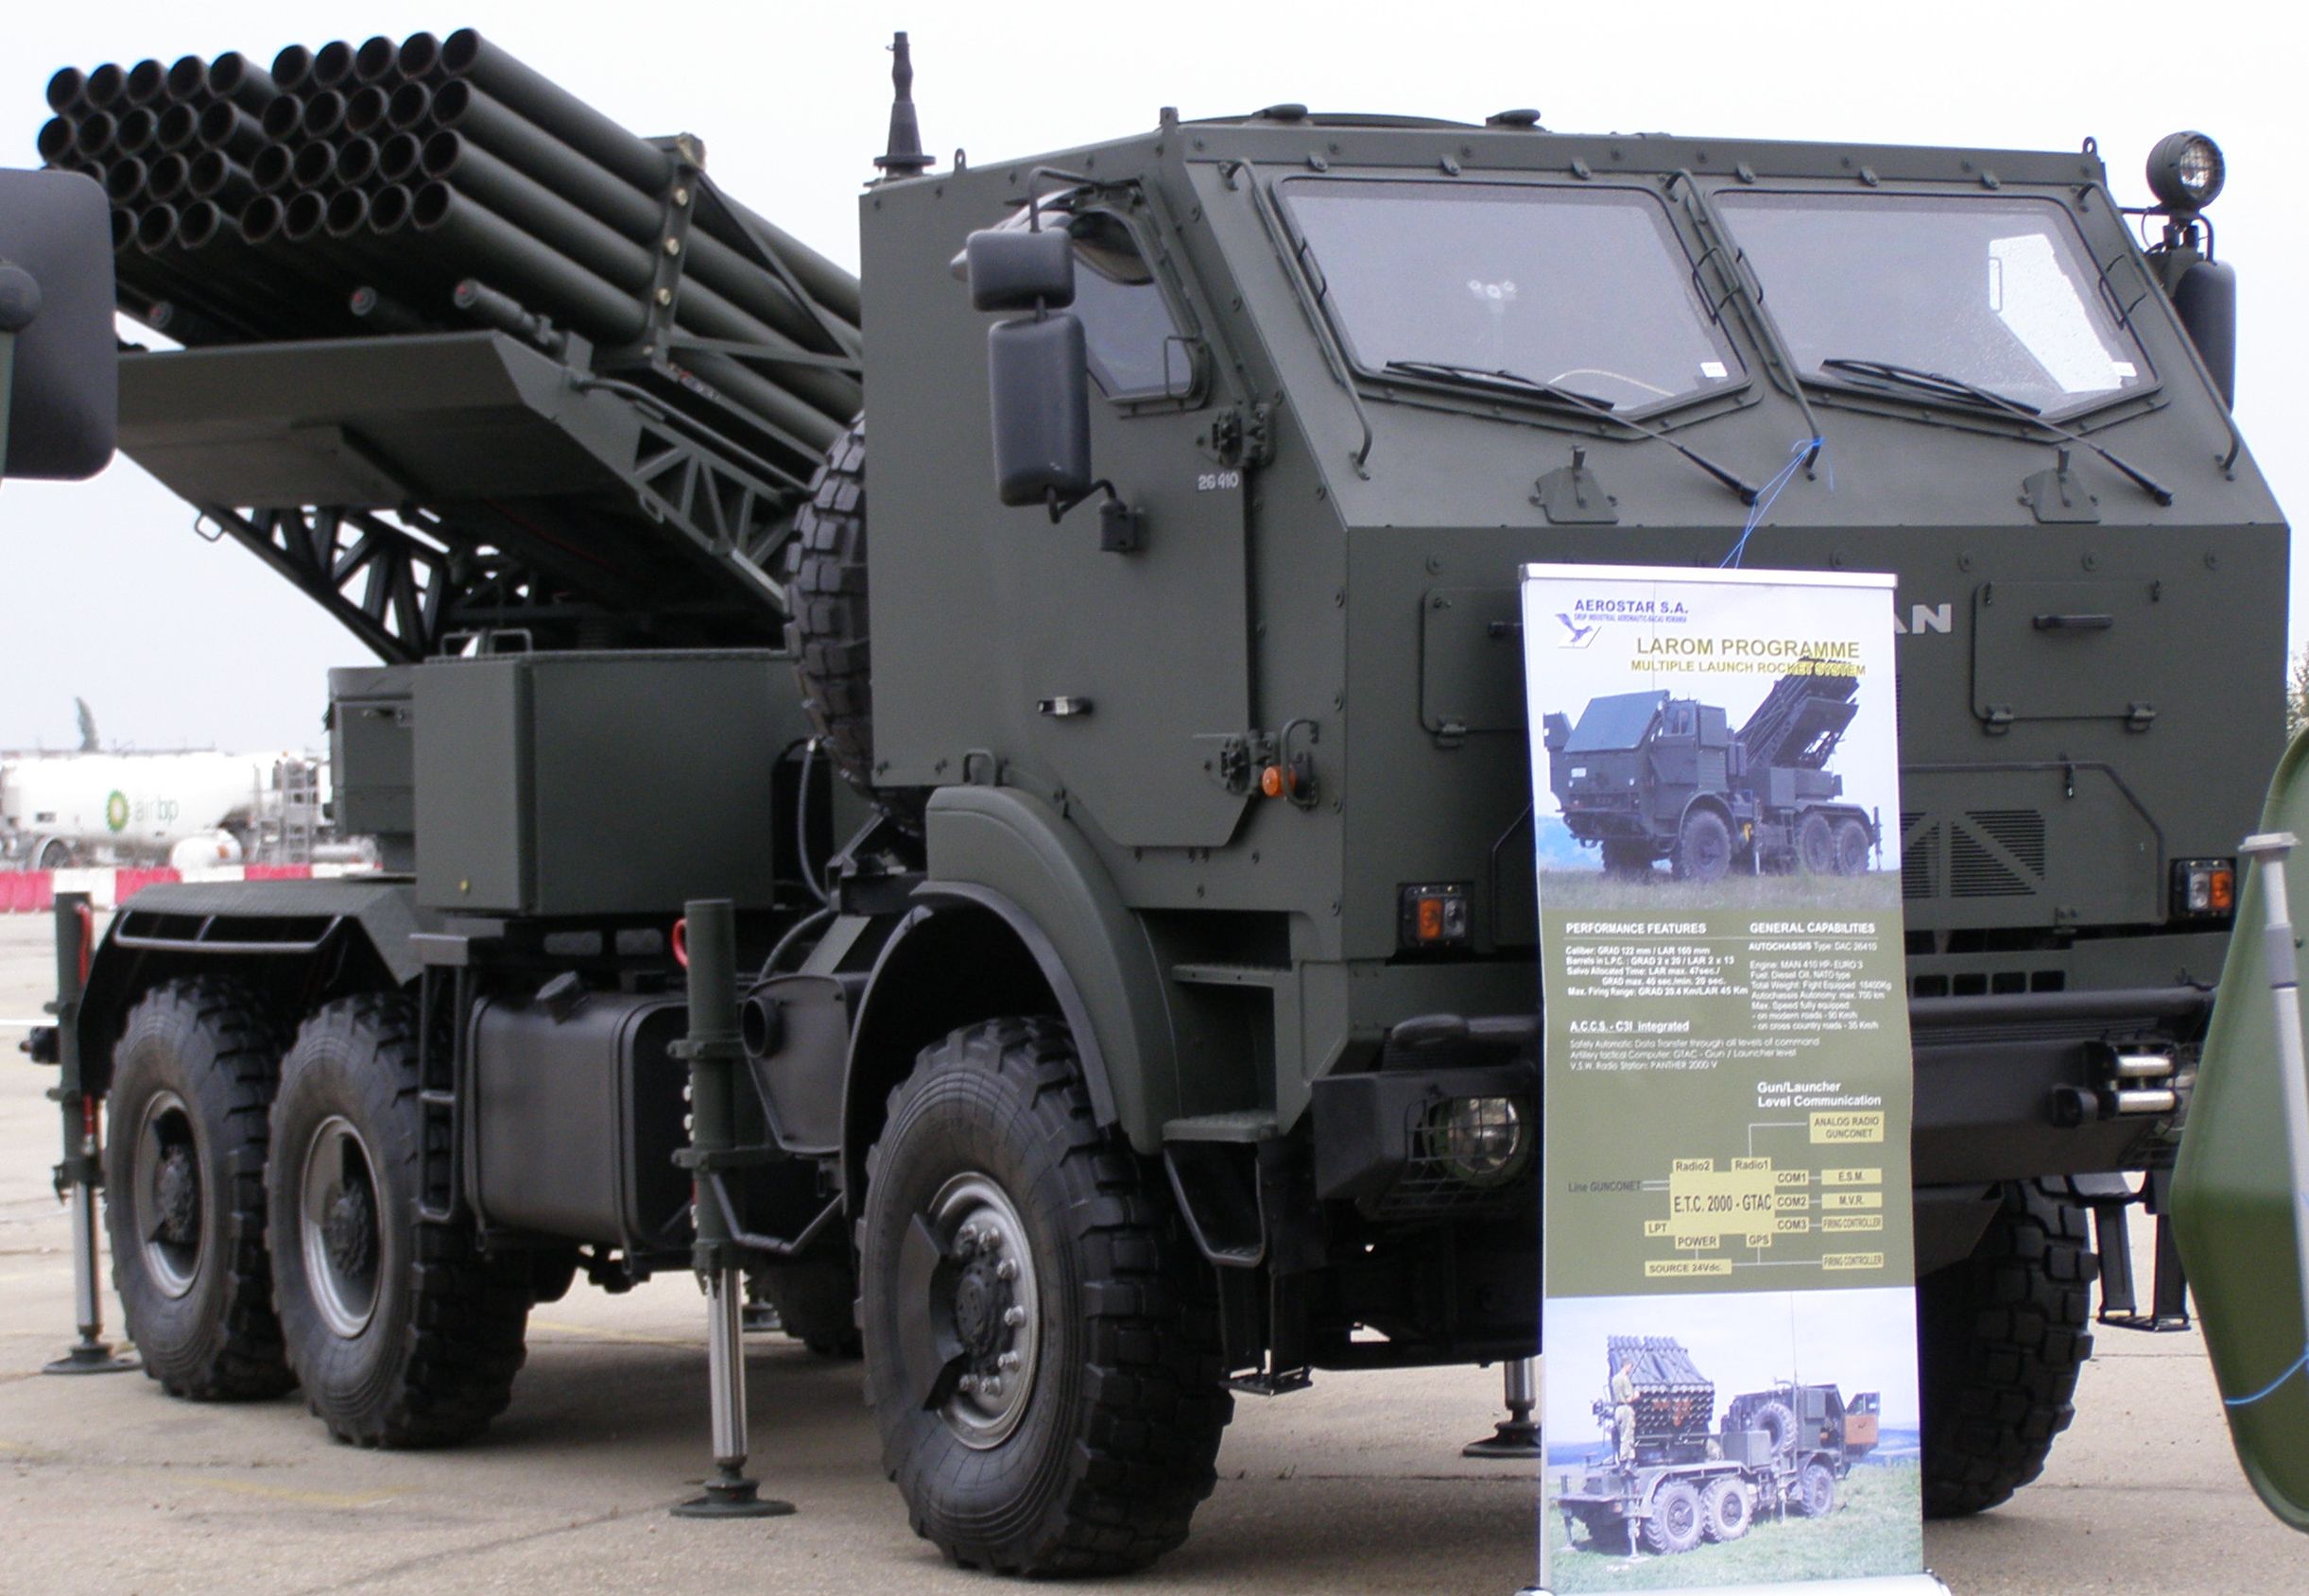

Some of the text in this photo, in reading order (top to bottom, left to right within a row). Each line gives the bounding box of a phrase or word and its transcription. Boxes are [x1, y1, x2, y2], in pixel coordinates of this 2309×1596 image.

[1198, 471, 1239, 490] 26 410
[1575, 599, 1689, 614] AEROSTAR S.A.
[1637, 638, 1860, 659] LAROM PROGRAMME
[1631, 660, 1866, 677] MULTIPLE LAUNCH ROCKET SYSTEM
[1565, 922, 1707, 935] PERFORMANCE FEATURES
[1749, 921, 1876, 934] GENERAL CAPABILITIES
[1597, 946, 1620, 955] GRAD
[1657, 946, 1676, 955] LAR
[1748, 941, 1812, 952] AUTOCHASSIS
[1630, 956, 1656, 965] GRAD
[1687, 956, 1706, 965] LAR
[1708, 955, 1715, 965] 2
[1780, 959, 1802, 970] MAN
[1834, 959, 1856, 970] EURO
[1648, 967, 1666, 975] LAR
[1602, 977, 1624, 986] GRAD
[1638, 987, 1663, 996] GRAD
[1757, 1081, 1841, 1093] Gun/Launcher
[1757, 1094, 1882, 1107] Level Communication
[1814, 1116, 1879, 1127] ANALOG RADIO
[1825, 1128, 1873, 1139] GUNCONET
[1675, 1160, 1711, 1171] Radio2
[1734, 1159, 1769, 1170] Radio1
[1777, 1173, 1806, 1183] COM1
[1568, 1182, 1588, 1193] Line
[1674, 1195, 1705, 1212] E.T.C.
[1707, 1194, 1732, 1211] 2000
[1742, 1193, 1772, 1211] GTAC
[1777, 1196, 1807, 1207] COM2
[1648, 1223, 1667, 1234] LPT
[1777, 1219, 1807, 1229] COM3
[1677, 1236, 1716, 1246] POWER
[1749, 1234, 1769, 1245] GPS
[1648, 1262, 1690, 1274] SOURCE
